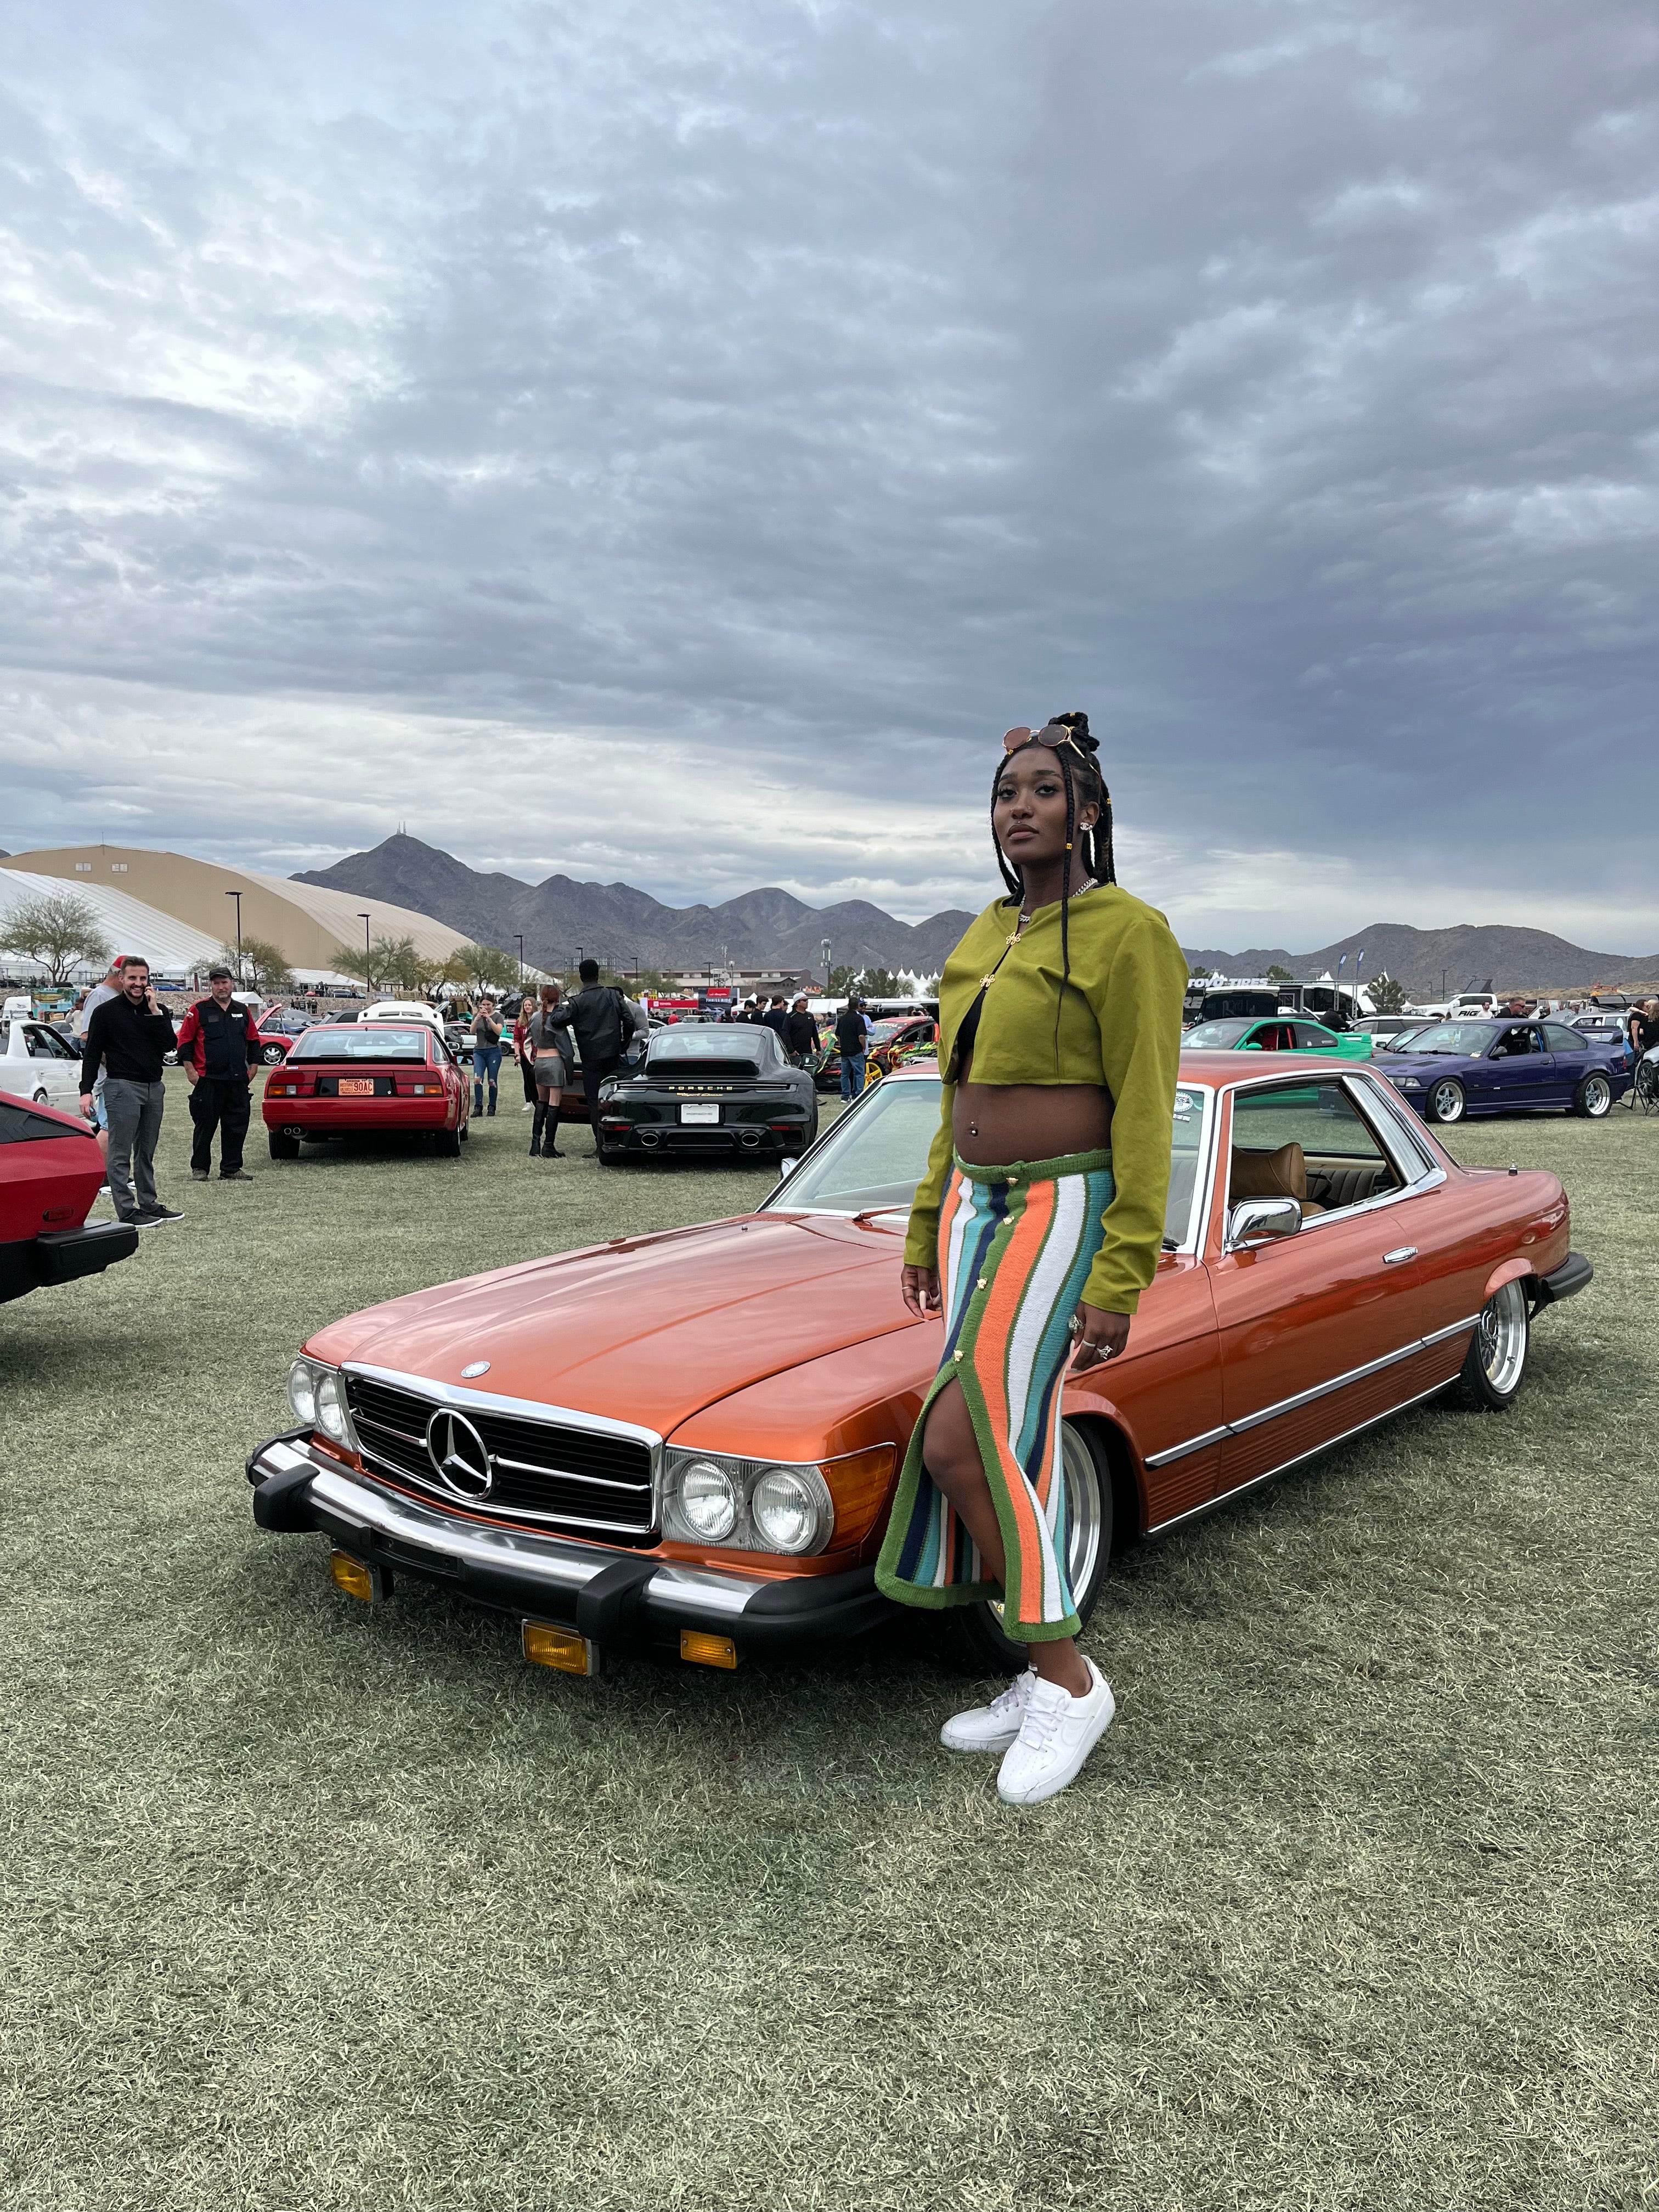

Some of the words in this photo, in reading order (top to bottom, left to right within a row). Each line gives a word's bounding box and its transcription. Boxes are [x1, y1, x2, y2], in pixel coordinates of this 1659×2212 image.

[1187, 978, 1224, 988] TOYO
[1229, 978, 1268, 986] TIRES
[354, 1082, 373, 1091] 90AC
